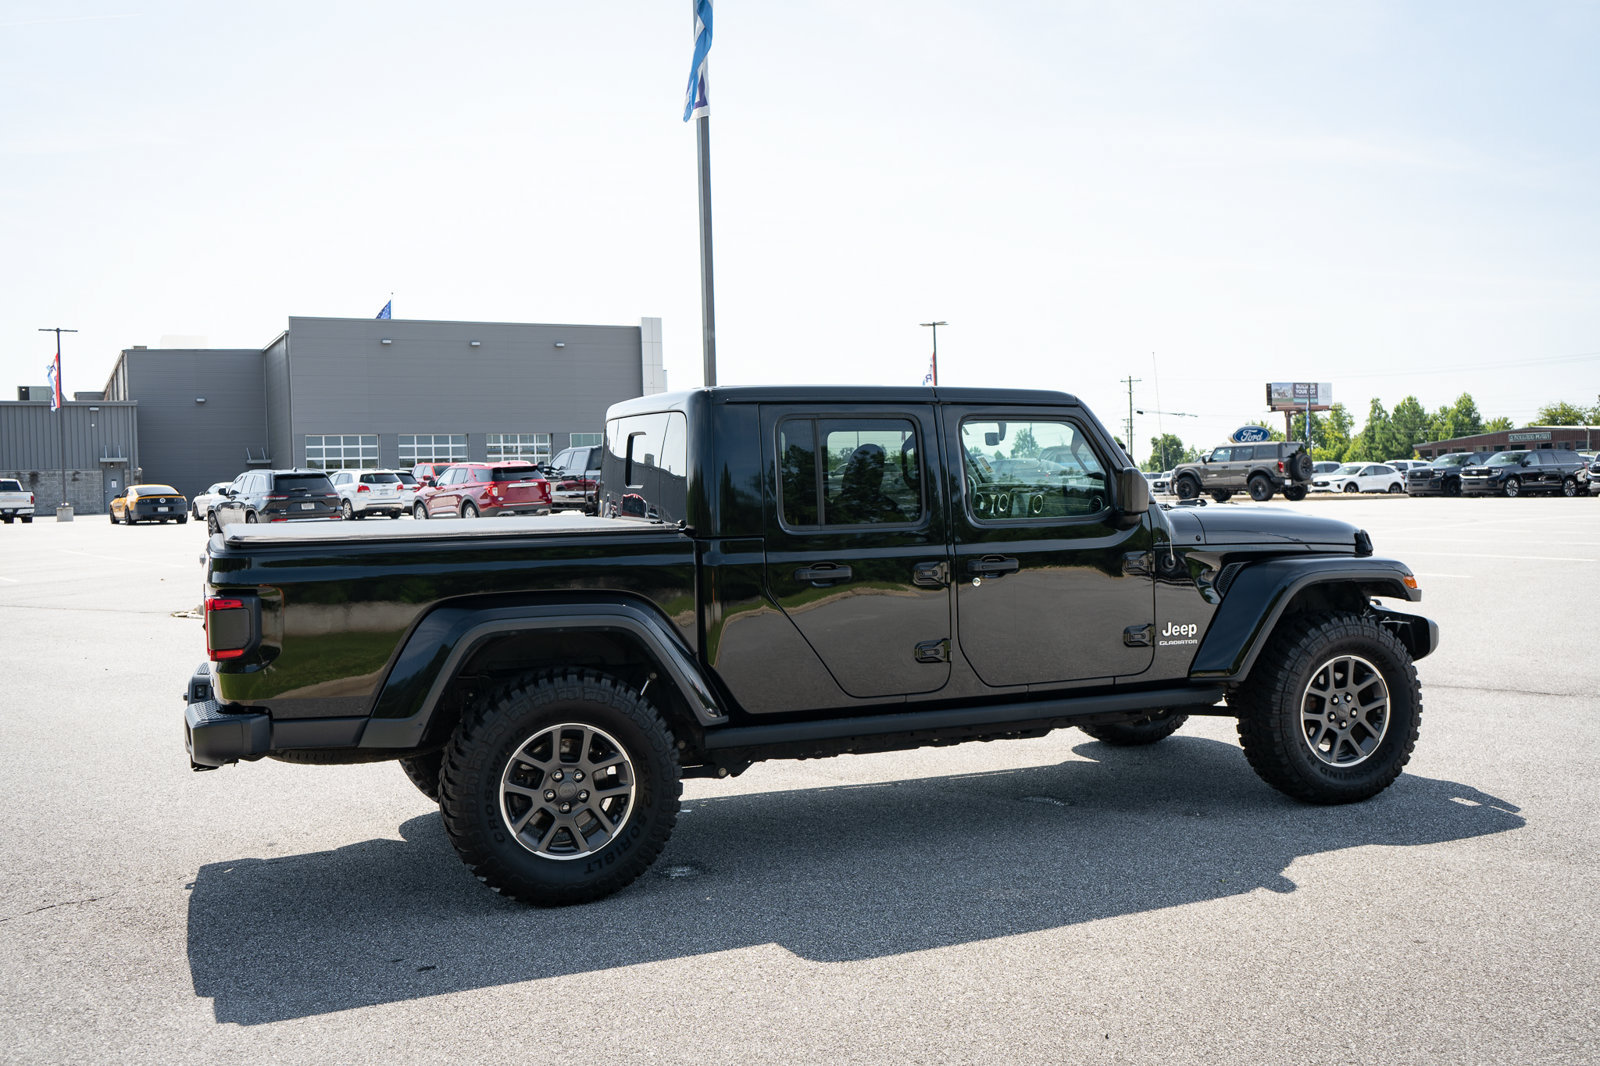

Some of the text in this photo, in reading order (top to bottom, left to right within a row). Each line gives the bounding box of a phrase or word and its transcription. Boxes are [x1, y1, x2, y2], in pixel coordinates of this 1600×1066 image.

[1241, 430, 1264, 441] Ford
[1162, 622, 1197, 637] Jeep
[485, 727, 527, 844] CROSSWIND
